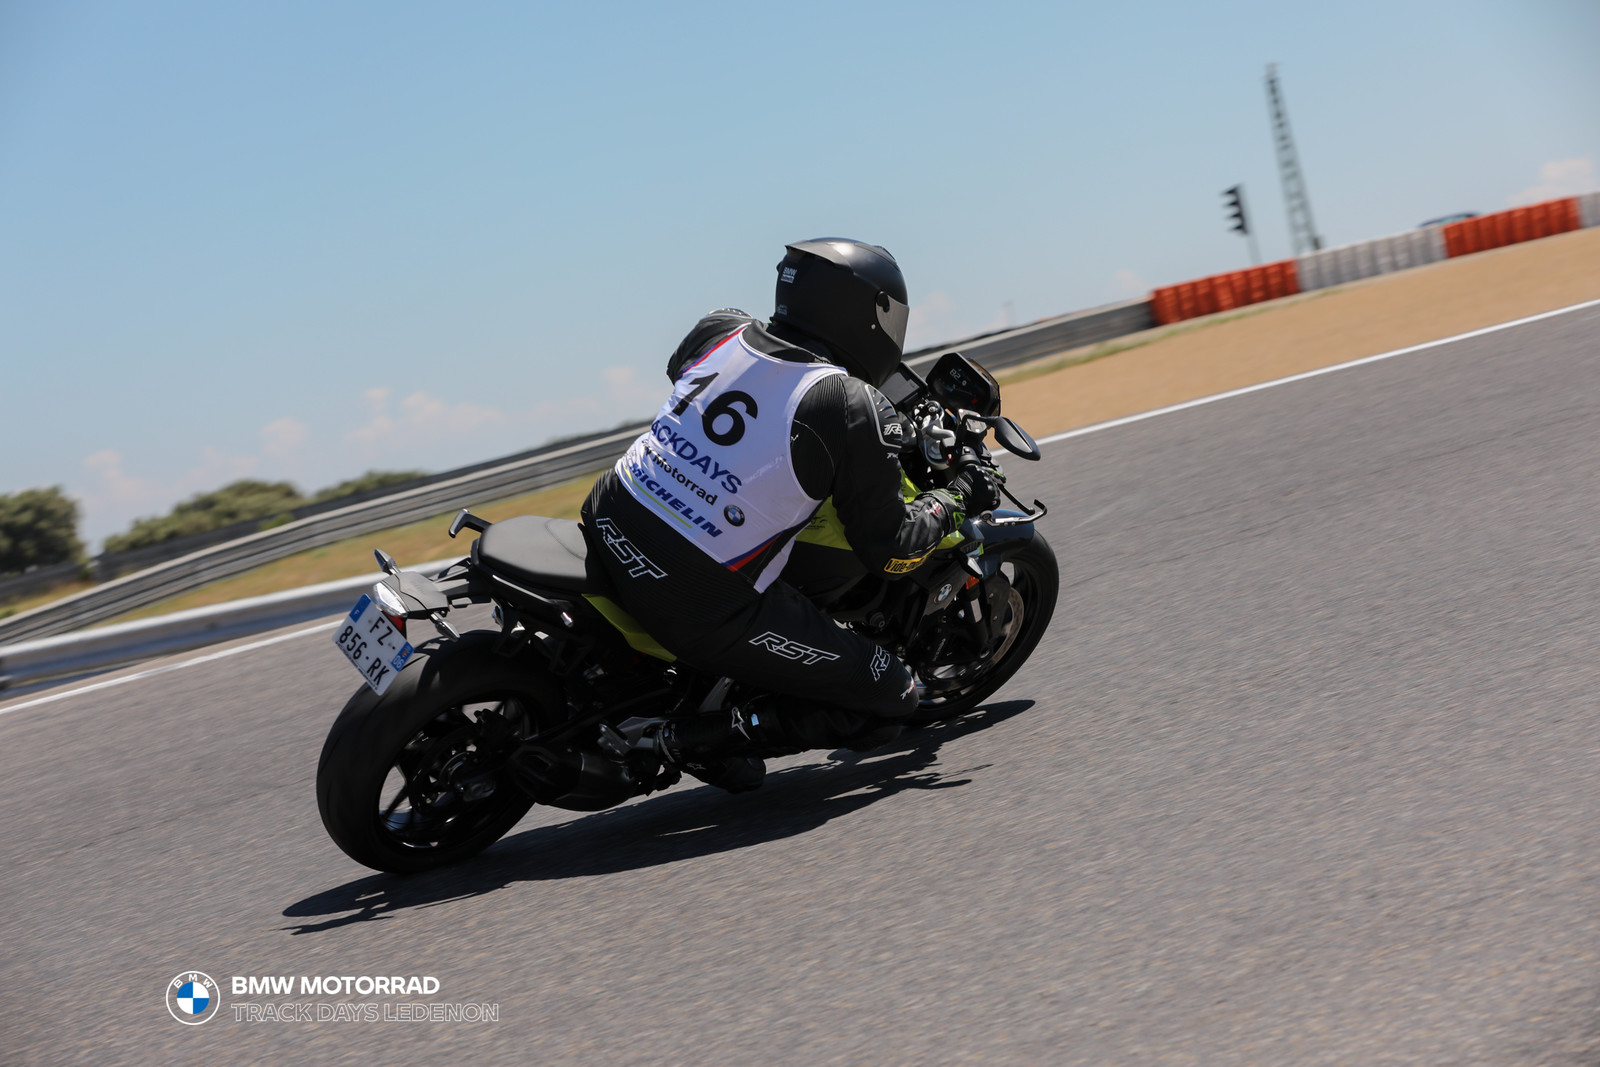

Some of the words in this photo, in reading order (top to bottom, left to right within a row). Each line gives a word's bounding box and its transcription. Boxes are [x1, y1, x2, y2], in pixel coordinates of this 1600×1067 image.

[672, 372, 759, 446] 16
[630, 463, 723, 538] MICHELIN
[652, 457, 718, 506] Motorrad
[596, 517, 668, 579] RST
[393, 655, 404, 669] 06
[749, 631, 841, 665] RST
